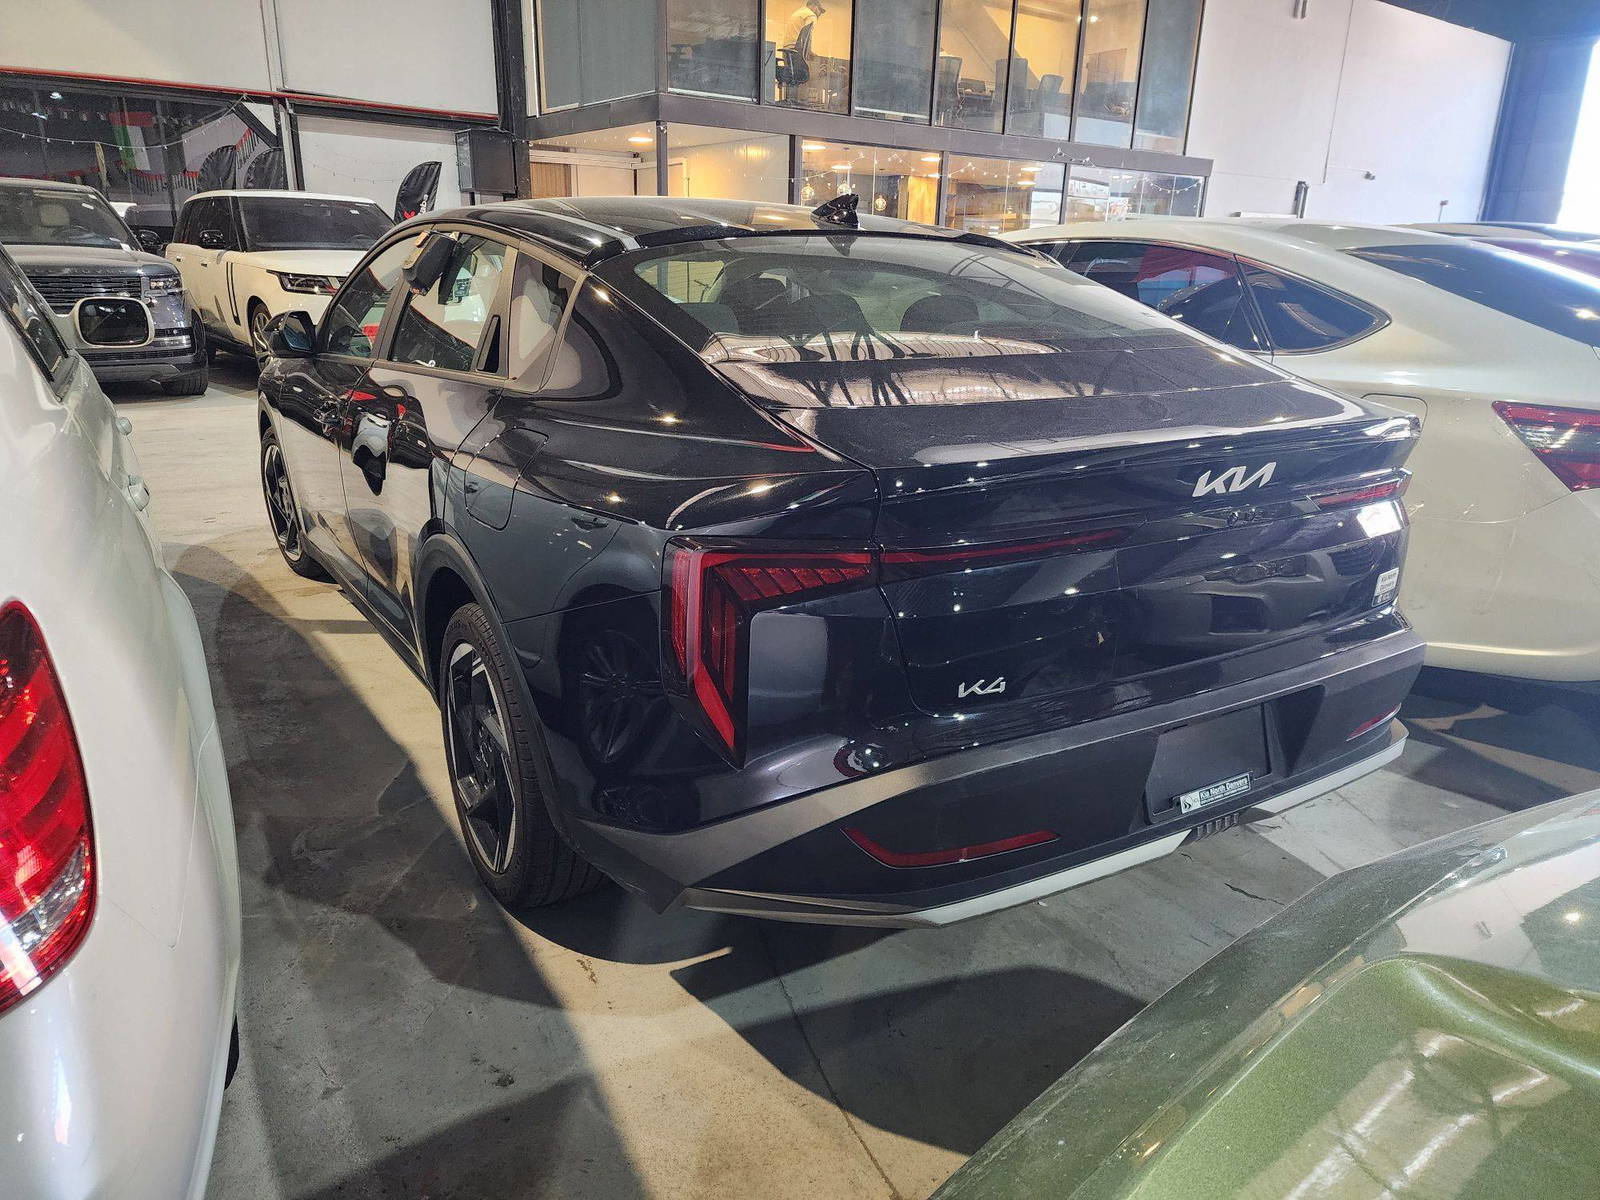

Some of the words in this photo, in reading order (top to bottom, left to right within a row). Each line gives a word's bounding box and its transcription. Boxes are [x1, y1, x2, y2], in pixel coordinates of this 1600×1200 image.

[1192, 461, 1276, 497] KIA
[958, 677, 1006, 698] K4
[1210, 784, 1225, 797] North
